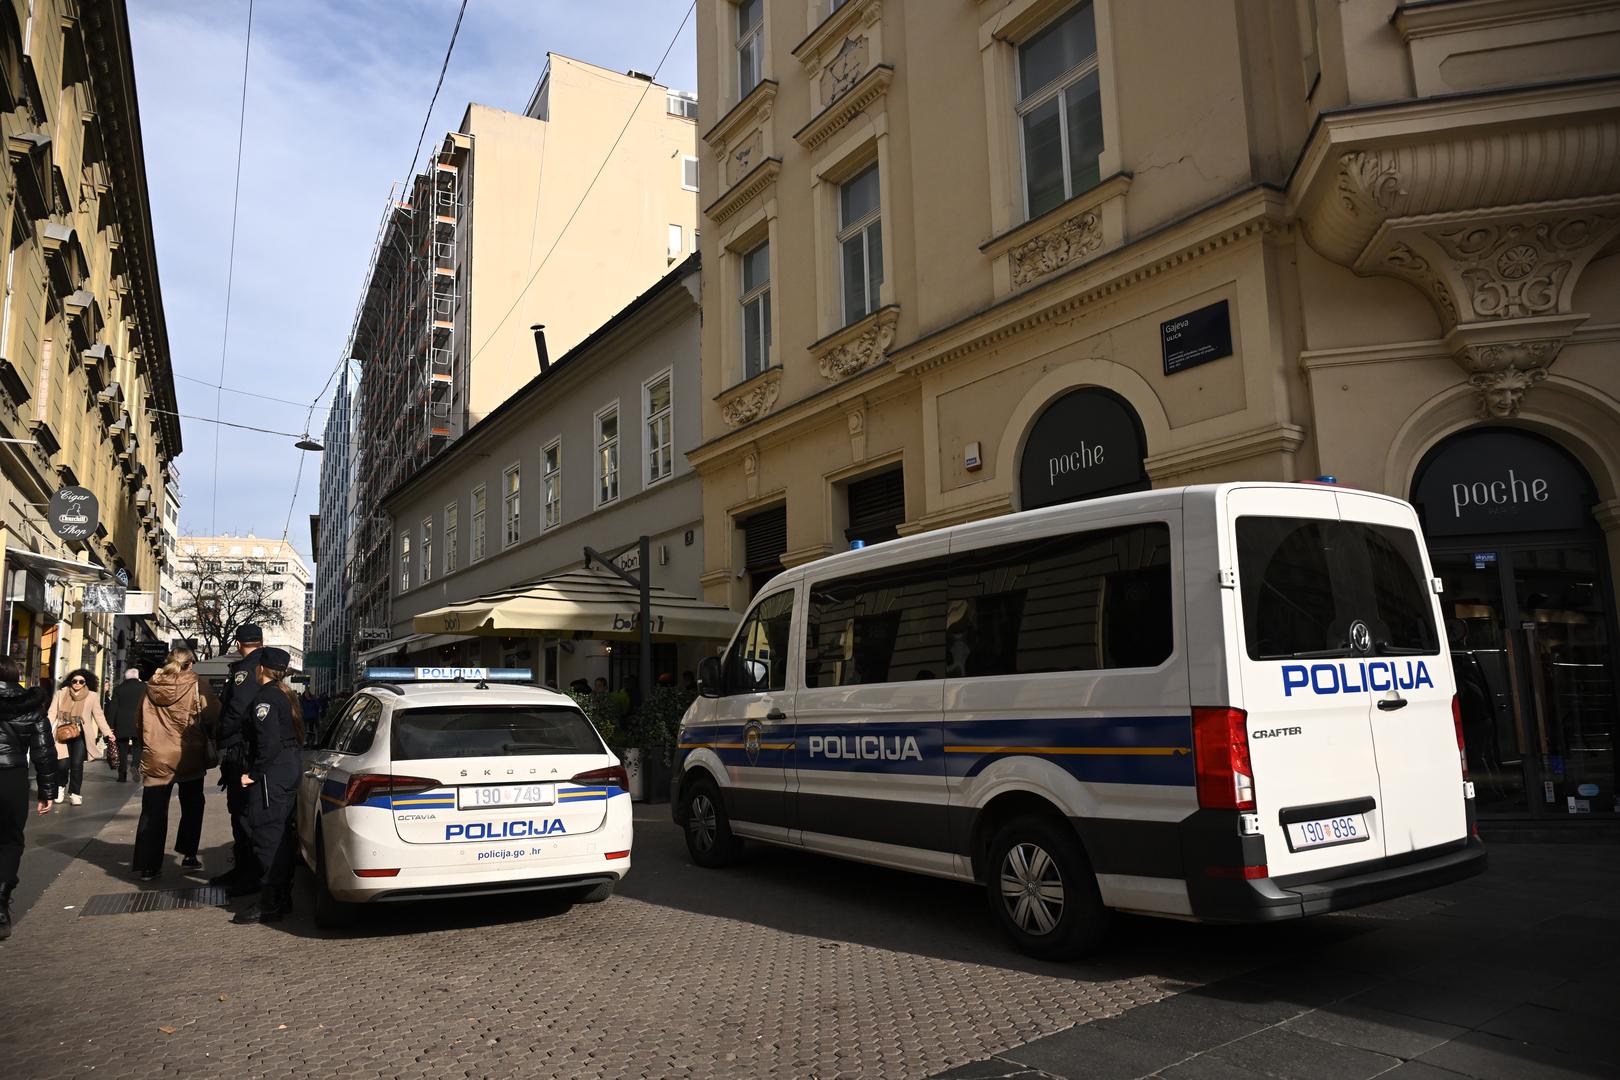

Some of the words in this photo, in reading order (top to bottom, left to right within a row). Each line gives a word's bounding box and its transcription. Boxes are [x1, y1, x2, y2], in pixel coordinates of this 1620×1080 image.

[1165, 319, 1189, 334] Gajeva
[1049, 440, 1104, 486] poche
[60, 490, 90, 503] Cigar
[1452, 469, 1549, 517] poche
[58, 524, 87, 537] Shop
[422, 668, 482, 679] POLICIJA
[1281, 660, 1434, 697] POLICIJA
[1252, 726, 1302, 739] CRAFTER
[809, 735, 923, 761] POLICIJA
[475, 788, 501, 805] 190
[514, 786, 541, 803] 749
[445, 818, 567, 841] POLICIJA
[1301, 822, 1325, 843] 190
[1331, 817, 1357, 838] 896
